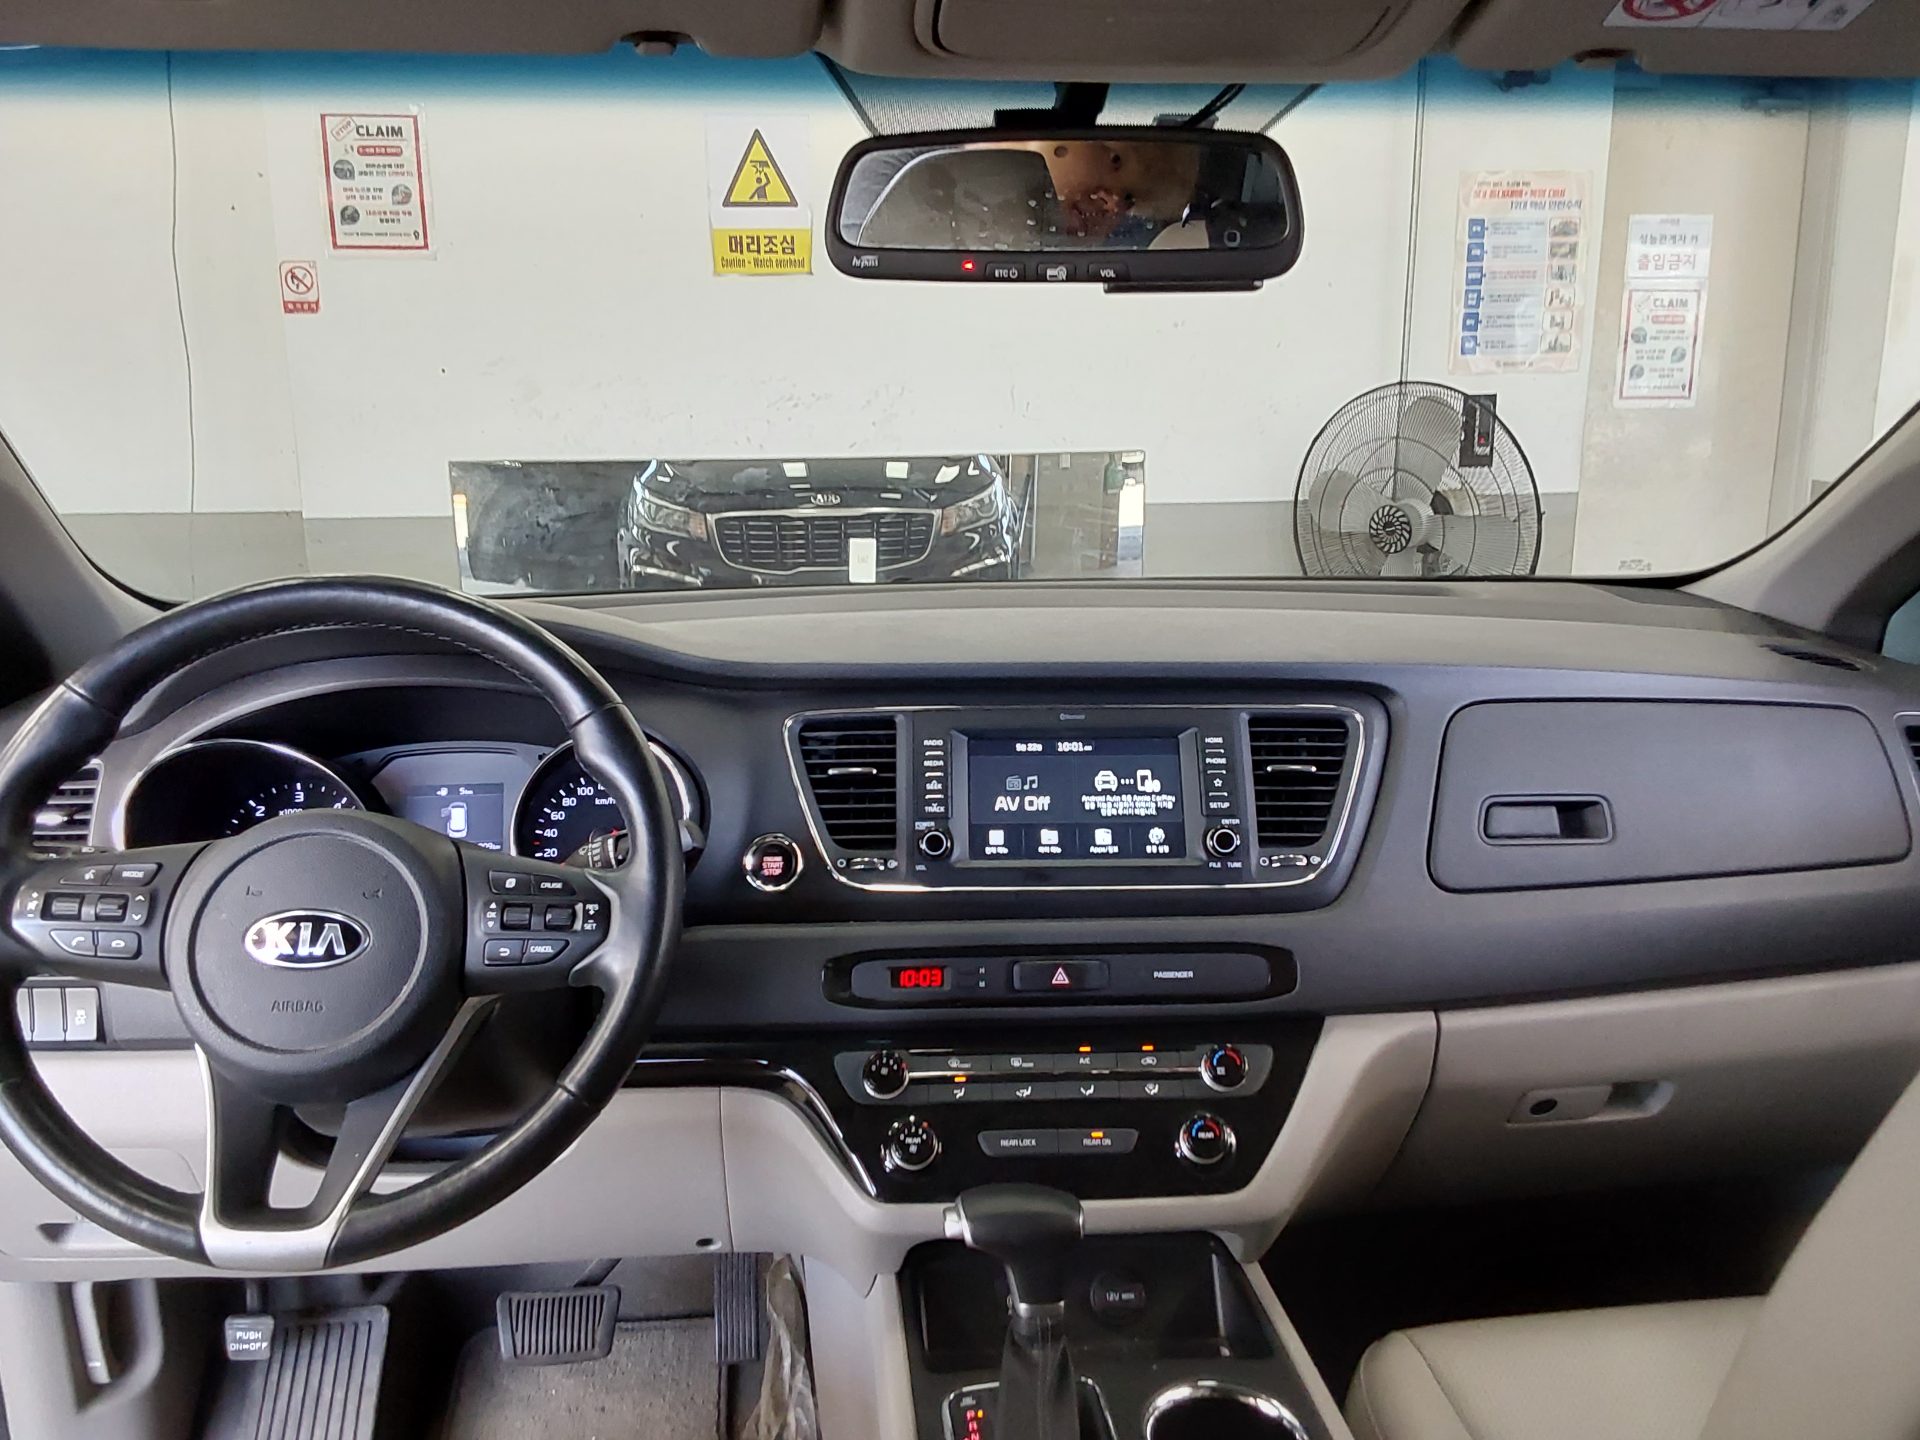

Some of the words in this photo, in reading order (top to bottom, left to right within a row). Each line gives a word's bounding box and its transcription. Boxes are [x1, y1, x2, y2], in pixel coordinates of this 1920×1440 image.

[355, 125, 404, 138] CLAIM
[728, 234, 796, 255] 머리조심
[721, 256, 746, 269] Caution
[753, 256, 774, 269] Watch
[775, 257, 805, 269] overhead
[1100, 269, 1116, 278] VOL
[1653, 298, 1689, 309] CLAIM
[1058, 742, 1084, 752] 10:01
[294, 791, 304, 802] 3
[577, 787, 594, 796] 100
[562, 798, 577, 806] 80
[594, 797, 616, 805] km/h
[995, 796, 1020, 812] AV
[1024, 795, 1051, 812] Off
[255, 806, 266, 817] 2
[550, 811, 566, 821] 60
[543, 829, 558, 838] 40
[543, 848, 558, 858] 20
[121, 870, 144, 878] MODE
[263, 921, 347, 956] KIA
[530, 945, 554, 953] CANCEL
[899, 967, 943, 989] 10:03
[271, 1000, 324, 1013] AIRBAG
[1079, 1058, 1091, 1066] A/C
[1000, 1139, 1018, 1147] REAR
[1019, 1139, 1036, 1147] LOCK
[1083, 1138, 1101, 1146] REAR
[1101, 1137, 1112, 1146] ON
[236, 1330, 262, 1340] PUSH
[966, 1409, 975, 1421] P
[968, 1420, 978, 1432] R
